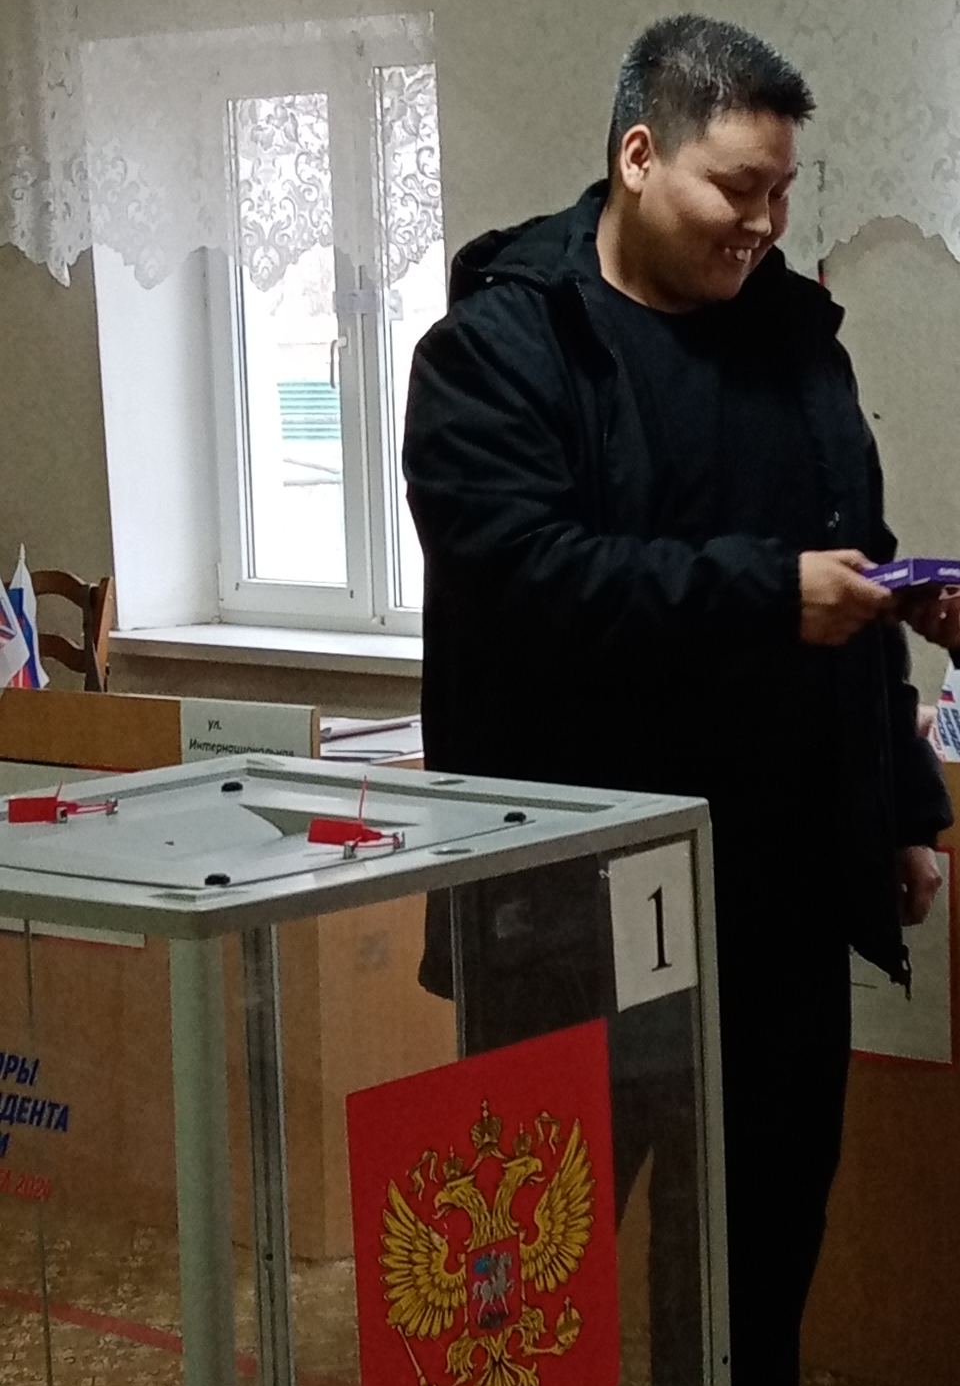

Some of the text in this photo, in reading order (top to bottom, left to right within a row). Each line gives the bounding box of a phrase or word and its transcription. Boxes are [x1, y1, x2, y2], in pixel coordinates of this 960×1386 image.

[208, 719, 222, 732] ул.
[647, 886, 673, 973] 1
[0, 1092, 69, 1132] ДЕНТА
